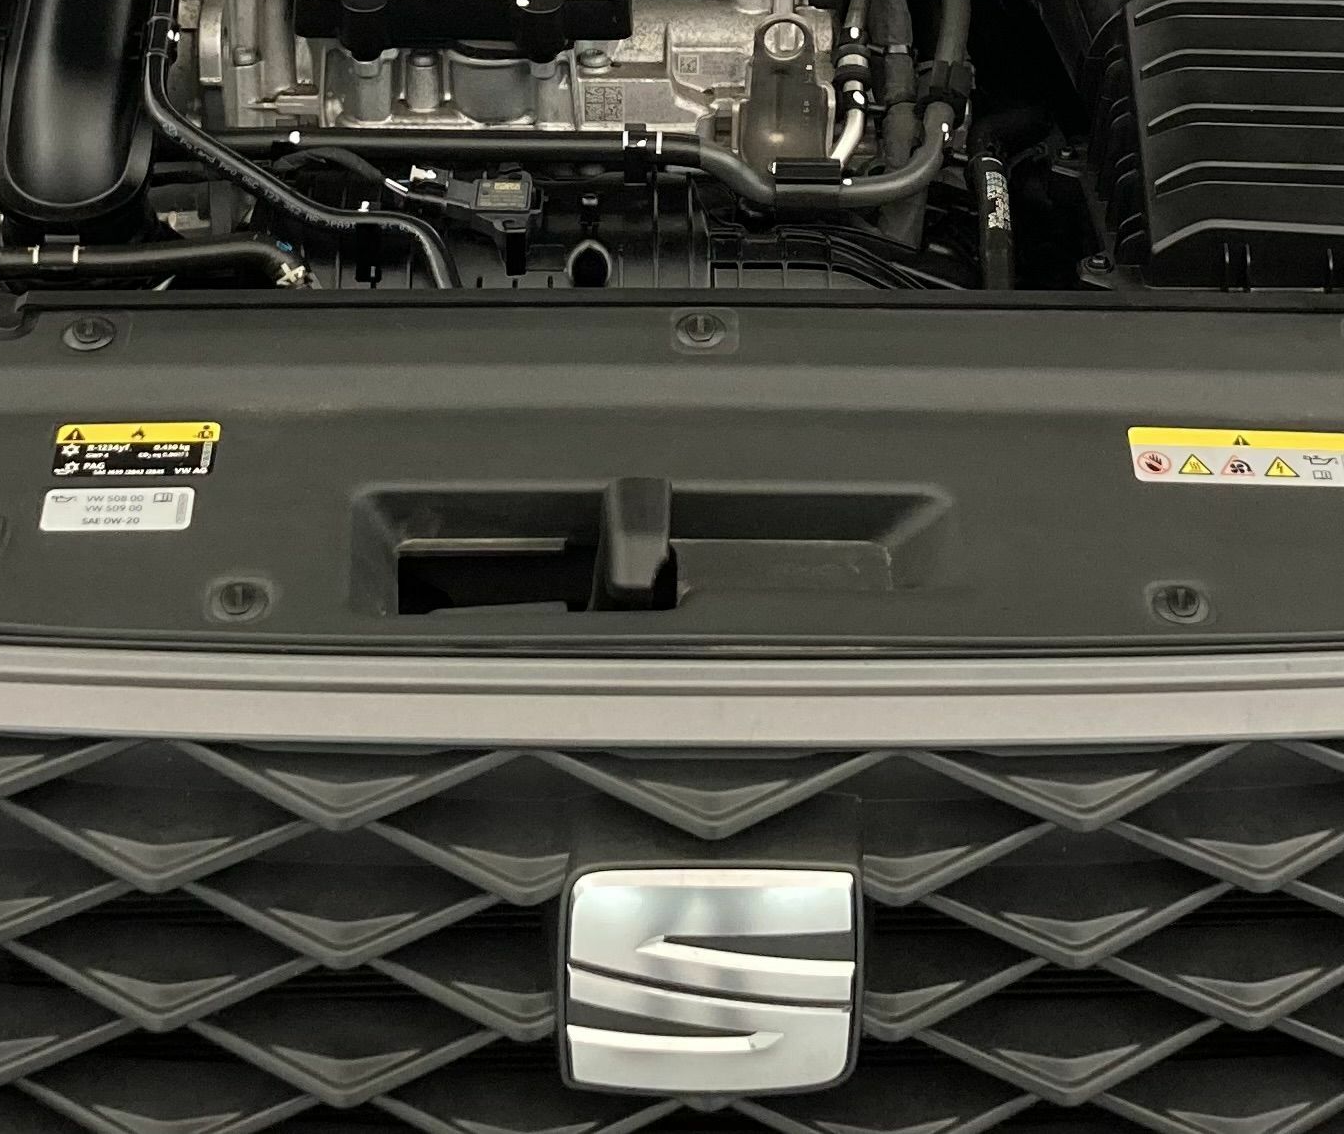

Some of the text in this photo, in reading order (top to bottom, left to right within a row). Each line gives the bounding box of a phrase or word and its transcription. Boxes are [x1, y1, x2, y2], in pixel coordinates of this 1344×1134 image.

[83, 462, 106, 470] PAG
[174, 467, 208, 475] VW AG
[82, 517, 140, 525] SAE 0W-20
